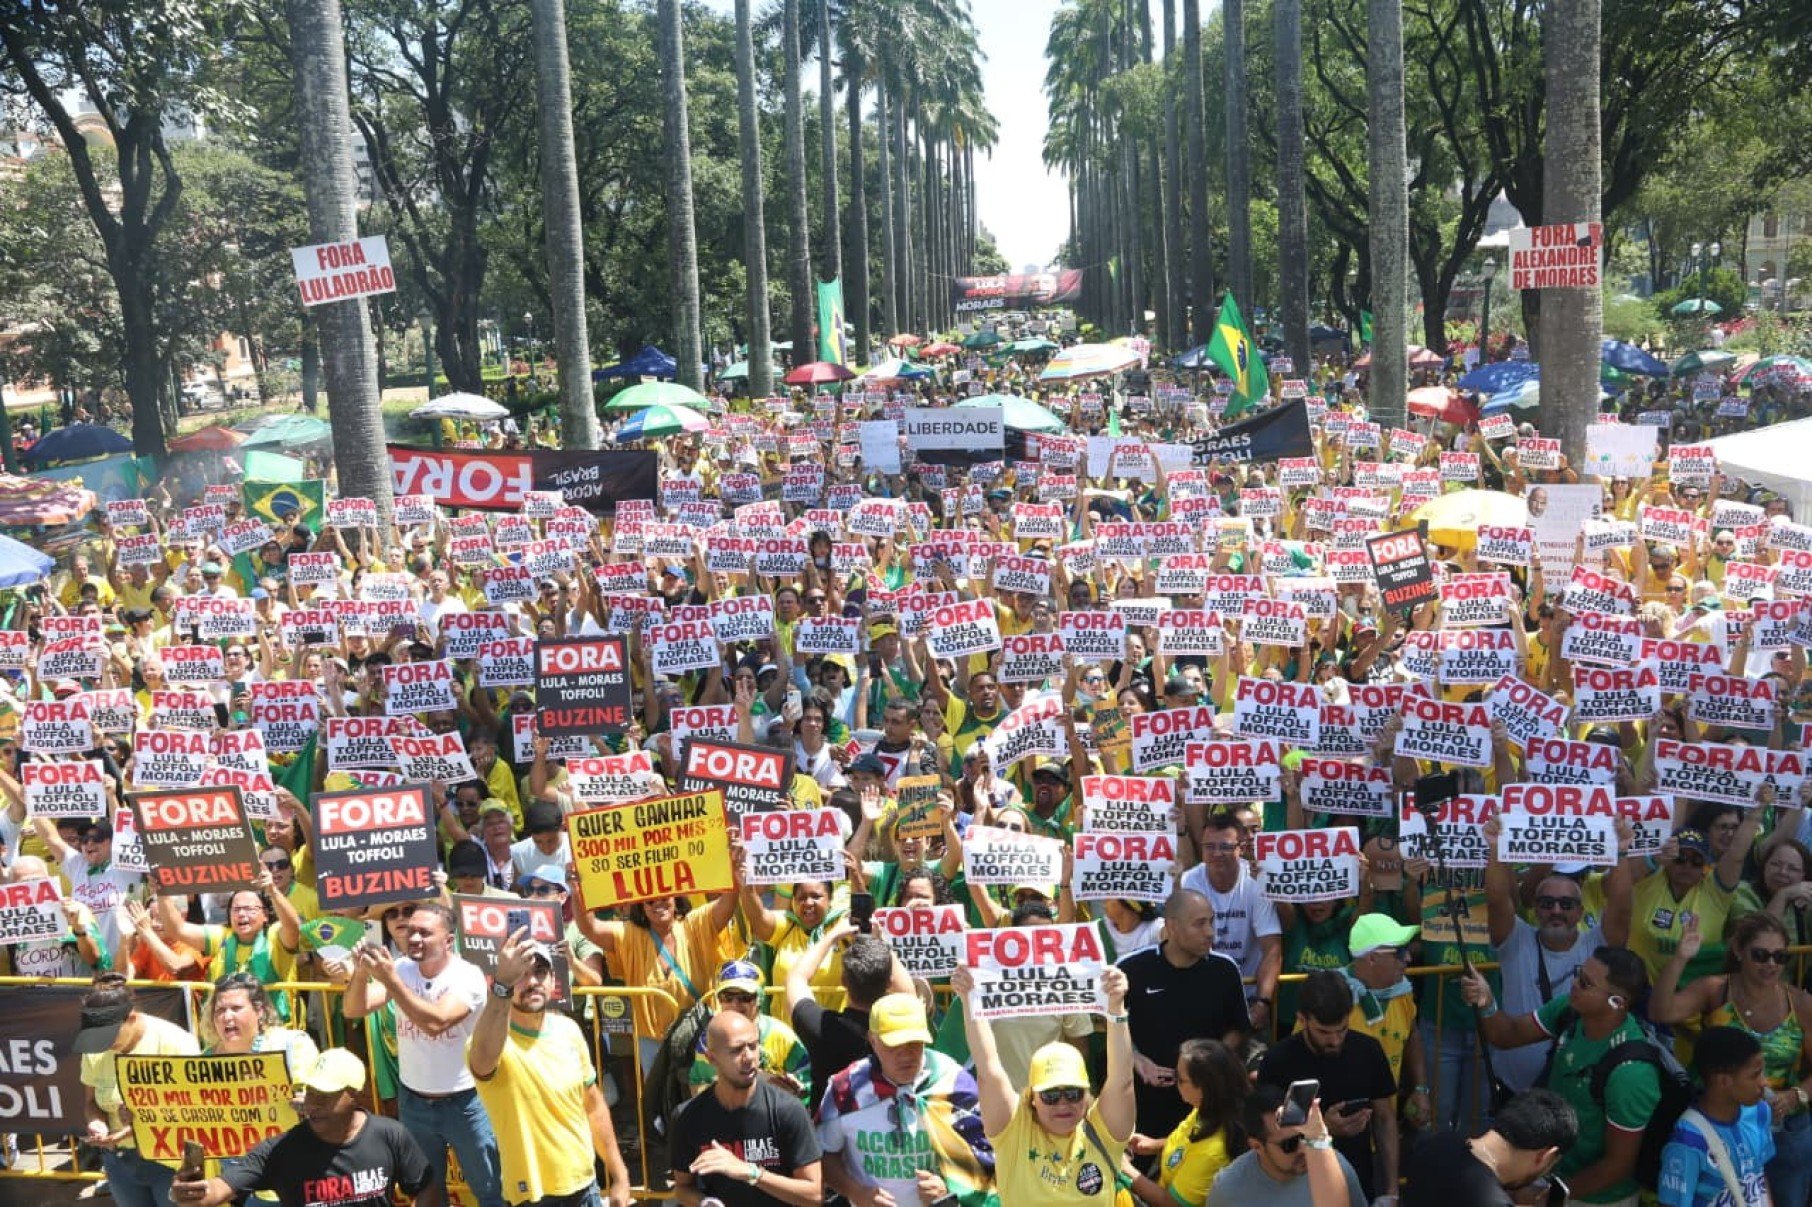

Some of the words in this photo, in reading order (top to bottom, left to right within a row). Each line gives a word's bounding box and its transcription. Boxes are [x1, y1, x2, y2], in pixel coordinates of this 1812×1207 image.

[1531, 222, 1577, 247] FORA
[316, 242, 366, 270] FORA
[1513, 246, 1598, 269] ALEXANDRE
[299, 264, 393, 303] LULADRÃO
[1513, 271, 1531, 289] DE
[1535, 266, 1598, 286] MORAES
[908, 421, 998, 434] LIBERDADE
[1194, 433, 1252, 452] ORAES
[1670, 446, 1714, 458] FORA
[391, 454, 532, 503] FORA
[1643, 507, 1690, 523] FORA
[1372, 533, 1419, 563] FORA
[442, 613, 508, 630] FORA
[1060, 613, 1123, 630] FORA
[651, 623, 713, 645] FORA
[1066, 637, 1119, 646] TOFFOLI
[1075, 630, 1108, 639] LULA
[1440, 631, 1515, 650] FORA
[161, 647, 222, 661] FORA
[658, 647, 712, 660] TOFFOLI
[667, 641, 700, 652] LULA
[1066, 645, 1119, 653] MORAES
[540, 641, 622, 672] FORA
[658, 655, 713, 668] MORAES
[383, 662, 452, 683] FORA
[540, 677, 567, 688] LULA
[577, 673, 625, 685] MORAES
[1575, 667, 1657, 690] FORA
[560, 688, 604, 700] TOFFOLI
[1594, 690, 1637, 701] LULA
[1400, 695, 1490, 728] FORA
[1581, 697, 1651, 709] TOFFOLI
[1581, 705, 1651, 717] MORAES
[542, 706, 625, 728] BUZINE
[1421, 722, 1467, 735] LULA
[135, 733, 207, 755] FORA
[1406, 727, 1482, 750] TOFFOLI
[1185, 742, 1278, 767] FORA
[1403, 738, 1480, 760] MORAES
[1657, 740, 1761, 774] FORA
[153, 753, 189, 764] LULA
[567, 750, 651, 775] FORA
[22, 765, 101, 786] FORA
[142, 762, 202, 774] TOFFOLI
[686, 747, 782, 788] FORA
[1209, 767, 1256, 778] LULA
[1303, 759, 1390, 783] FORA
[1683, 762, 1734, 780] LULA
[141, 771, 200, 783] MORAES
[589, 774, 632, 785] LULA
[1194, 777, 1271, 788] TOFFOLI
[1664, 768, 1751, 789] TOFFOLI
[45, 784, 86, 795] LULA
[577, 781, 651, 794] TOFFOLI
[578, 787, 649, 799] MORAES
[728, 784, 780, 803] MORAES
[1085, 777, 1172, 803] FORA
[1193, 787, 1271, 797] MORAES
[1310, 788, 1383, 802] TOFFOLI
[1324, 780, 1369, 793] LULA
[1661, 779, 1751, 799] MORAES
[32, 793, 99, 804] TOFFOLI
[33, 801, 99, 812] MORAES
[1106, 800, 1151, 812] LULA
[1308, 798, 1382, 811] MORAES
[1503, 786, 1616, 816] FORA
[139, 795, 239, 828] FORA
[320, 792, 425, 831] FORA
[577, 811, 625, 838] QUER
[634, 795, 708, 828] GANHAR
[1092, 810, 1166, 822] TOFFOLI
[742, 811, 841, 841] FORA
[1092, 820, 1167, 832] MORAES
[1529, 817, 1586, 830] LULA
[147, 830, 182, 845] LULA
[190, 827, 245, 841] MORAES
[322, 836, 357, 849] LULA
[364, 829, 427, 845] MORAES
[577, 838, 611, 859] 300
[614, 835, 637, 853] MIL
[643, 827, 673, 847] POR
[1509, 827, 1605, 844] TOFFOLI
[173, 844, 225, 858] TOFFOLI
[769, 839, 818, 852] LULA
[1075, 836, 1174, 861] FORA
[1256, 829, 1358, 860] FORA
[1508, 840, 1605, 856] MORAES
[347, 848, 405, 864] TOFFOLI
[616, 852, 642, 869] SER
[645, 845, 679, 865] FILHO
[688, 840, 705, 857] DO
[752, 850, 834, 865] TOFFOLI
[158, 862, 254, 887] BUZINE
[754, 861, 835, 877] MORAES
[1100, 861, 1150, 872] LULA
[1282, 859, 1333, 873] LULA
[326, 866, 431, 898] BUZINE
[612, 860, 696, 900] LULA
[1083, 871, 1165, 883] TOFFOLI
[1268, 868, 1349, 884] TOFFOLI
[1081, 882, 1163, 894] MORAES
[1266, 880, 1349, 895] MORAES
[461, 905, 556, 938] FOA
[465, 938, 495, 951] LULA
[965, 926, 1102, 968] FORA
[1002, 966, 1071, 981] LULA
[981, 978, 1095, 994] TOFFOLI
[981, 991, 1096, 1010] MORAES
[127, 1060, 176, 1085] QUER
[184, 1058, 267, 1084] GANHAR
[128, 1086, 159, 1107] 120
[163, 1089, 196, 1106] MIL
[200, 1087, 234, 1106] POR
[238, 1085, 270, 1106] DIA
[162, 1107, 178, 1123] SE
[180, 1106, 227, 1123] CASAR
[231, 1107, 263, 1123] COM
[268, 1107, 277, 1122] O
[304, 1175, 353, 1204] FORA
